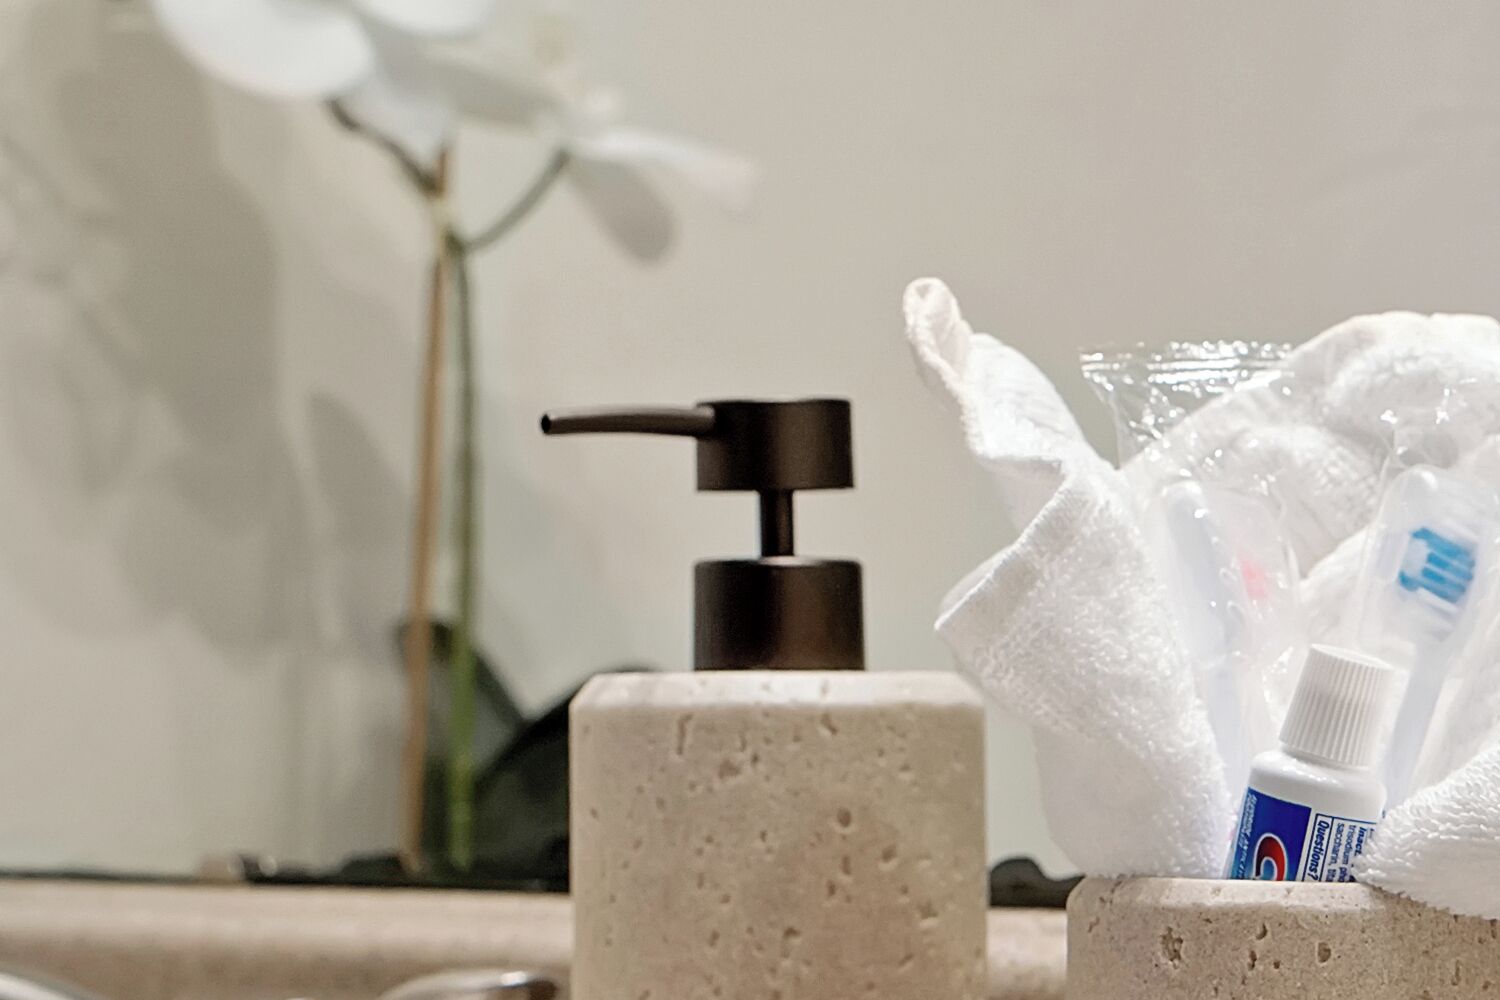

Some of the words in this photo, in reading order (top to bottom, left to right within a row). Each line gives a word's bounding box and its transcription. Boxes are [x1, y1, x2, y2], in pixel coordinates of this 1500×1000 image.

[1307, 819, 1330, 881] Questions?
[1327, 822, 1345, 866] saccharin,
[1354, 826, 1367, 857] Inact
